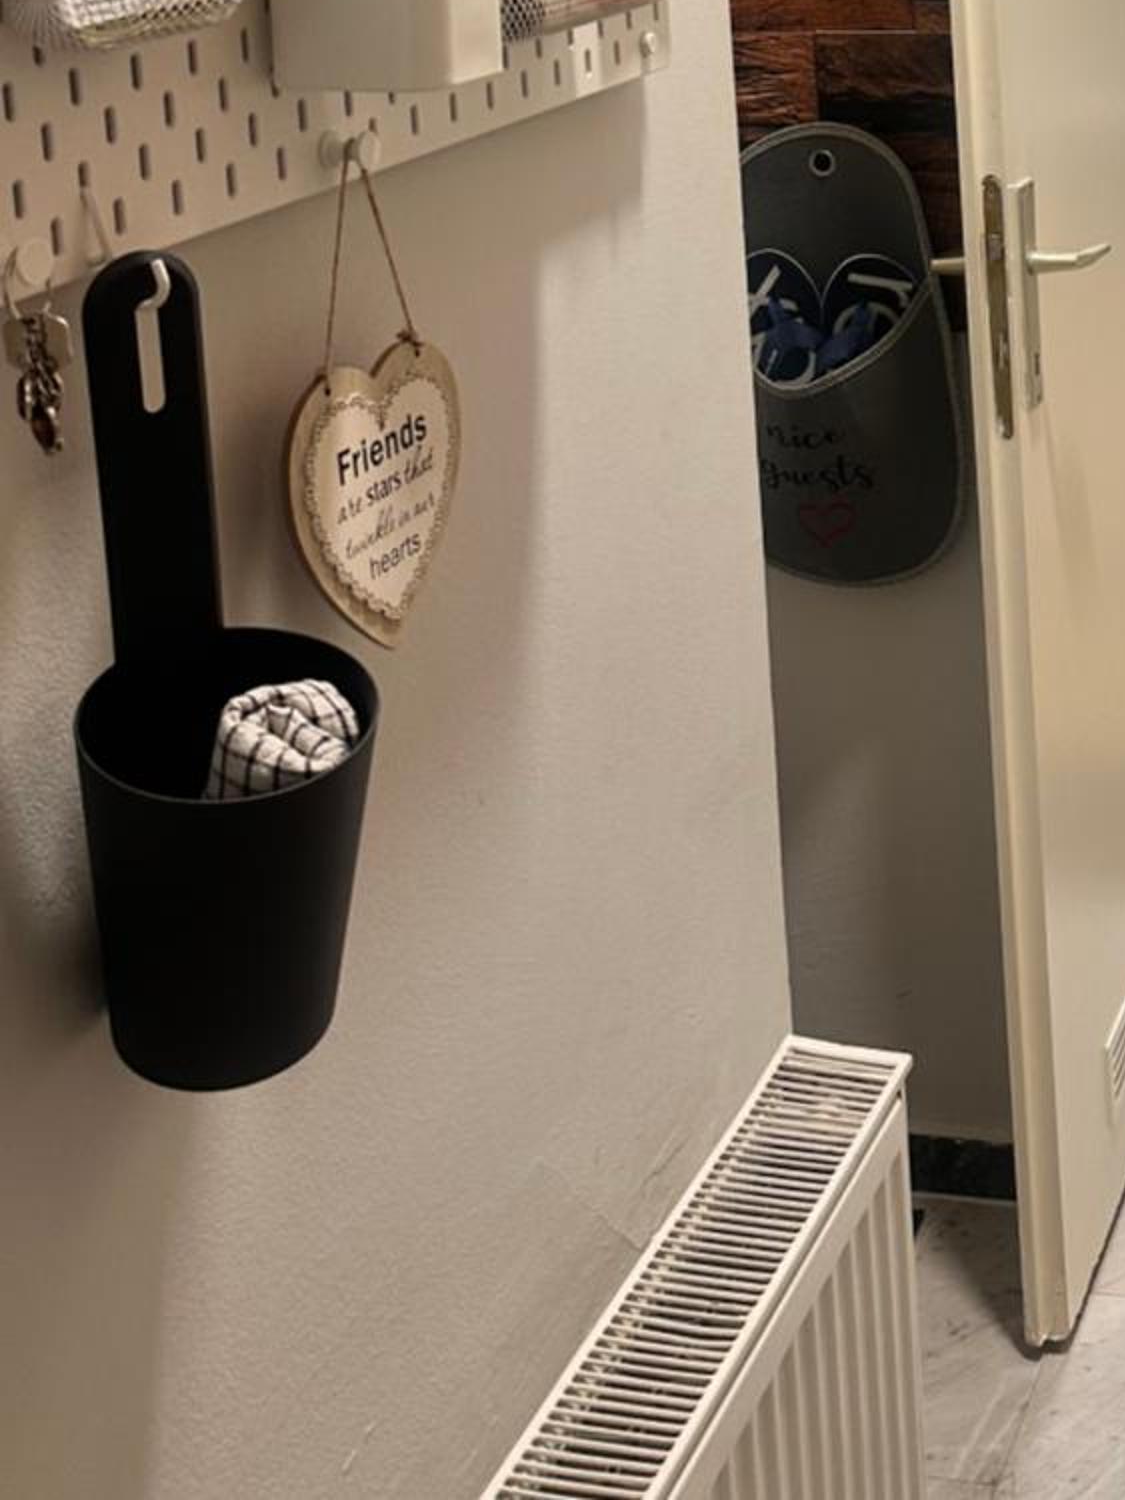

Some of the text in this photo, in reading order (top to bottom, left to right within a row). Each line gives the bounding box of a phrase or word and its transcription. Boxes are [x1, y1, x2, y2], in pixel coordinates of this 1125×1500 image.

[337, 414, 428, 487] Friends
[337, 445, 434, 526] are stars that
[369, 533, 421, 581] hearts
